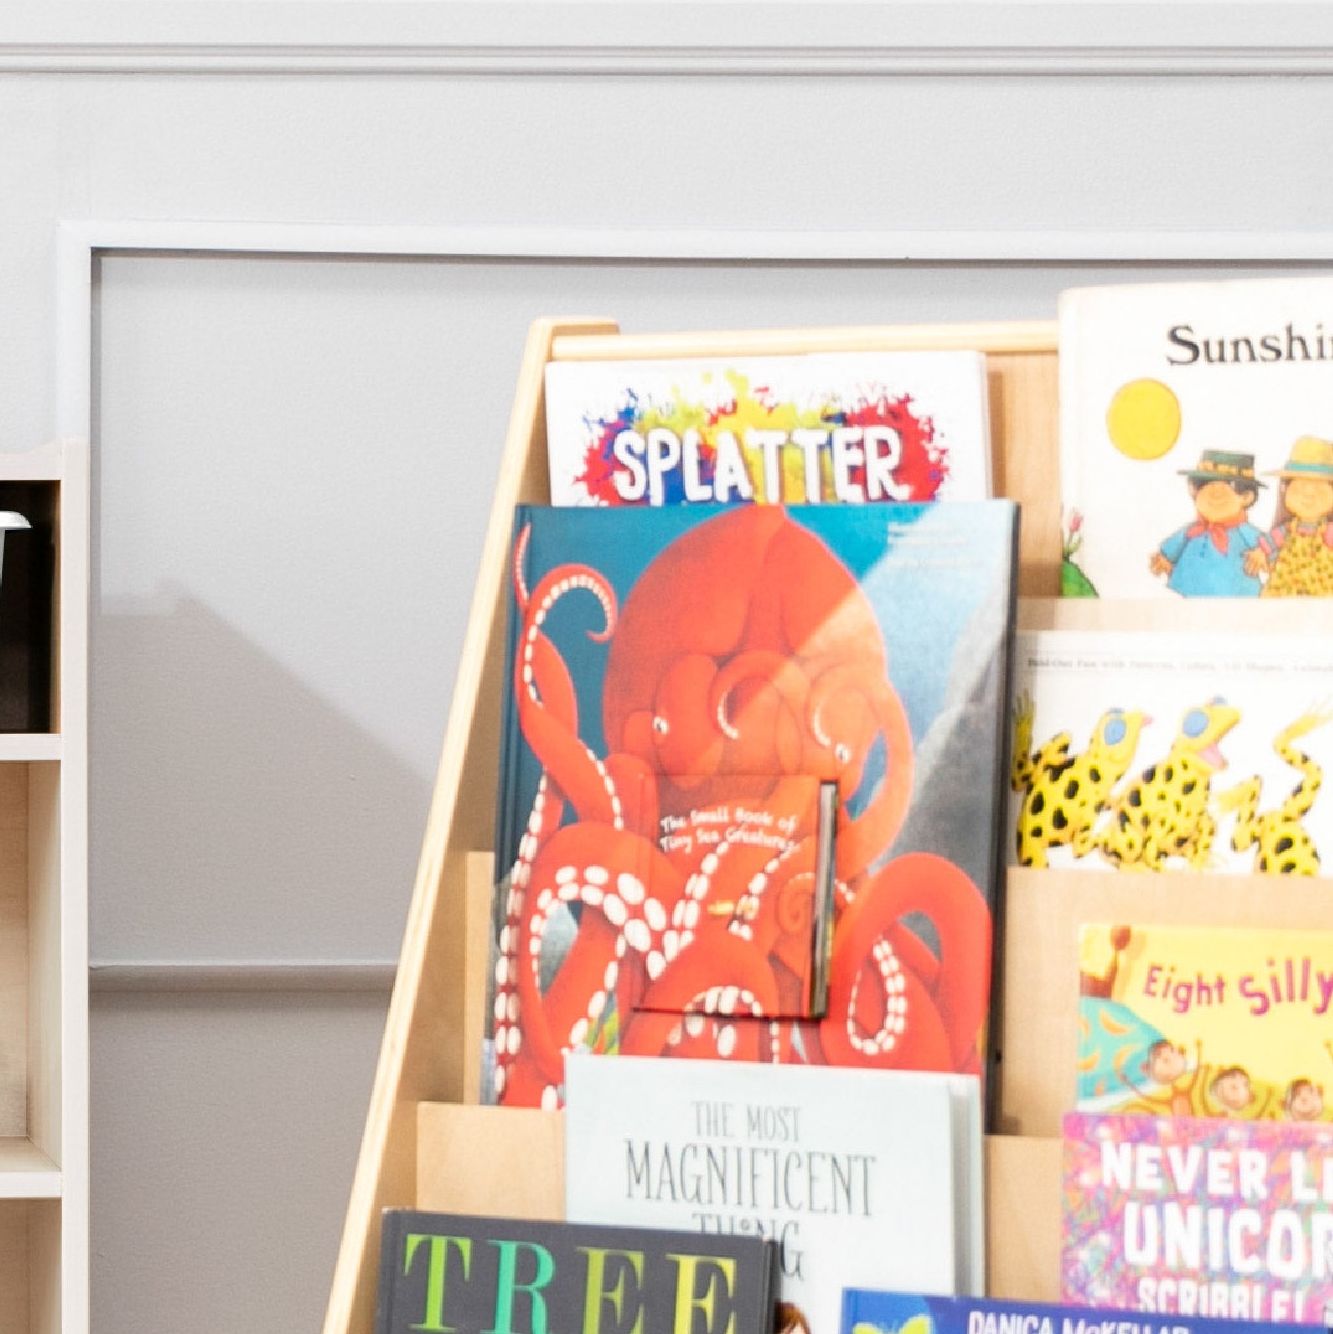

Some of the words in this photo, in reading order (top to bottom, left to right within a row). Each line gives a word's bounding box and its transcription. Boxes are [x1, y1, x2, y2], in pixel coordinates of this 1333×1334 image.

[1166, 322, 1333, 365] Sunshi
[613, 425, 910, 506] SPLATTER
[690, 807, 729, 826] Small
[736, 807, 773, 826] Book
[778, 815, 797, 835] of
[1144, 963, 1225, 1014] Eight
[692, 1100, 733, 1138] THE
[746, 1104, 800, 1142] MOST
[625, 1138, 876, 1215] MAGNIFICENT
[1101, 1140, 1267, 1200] NEVER
